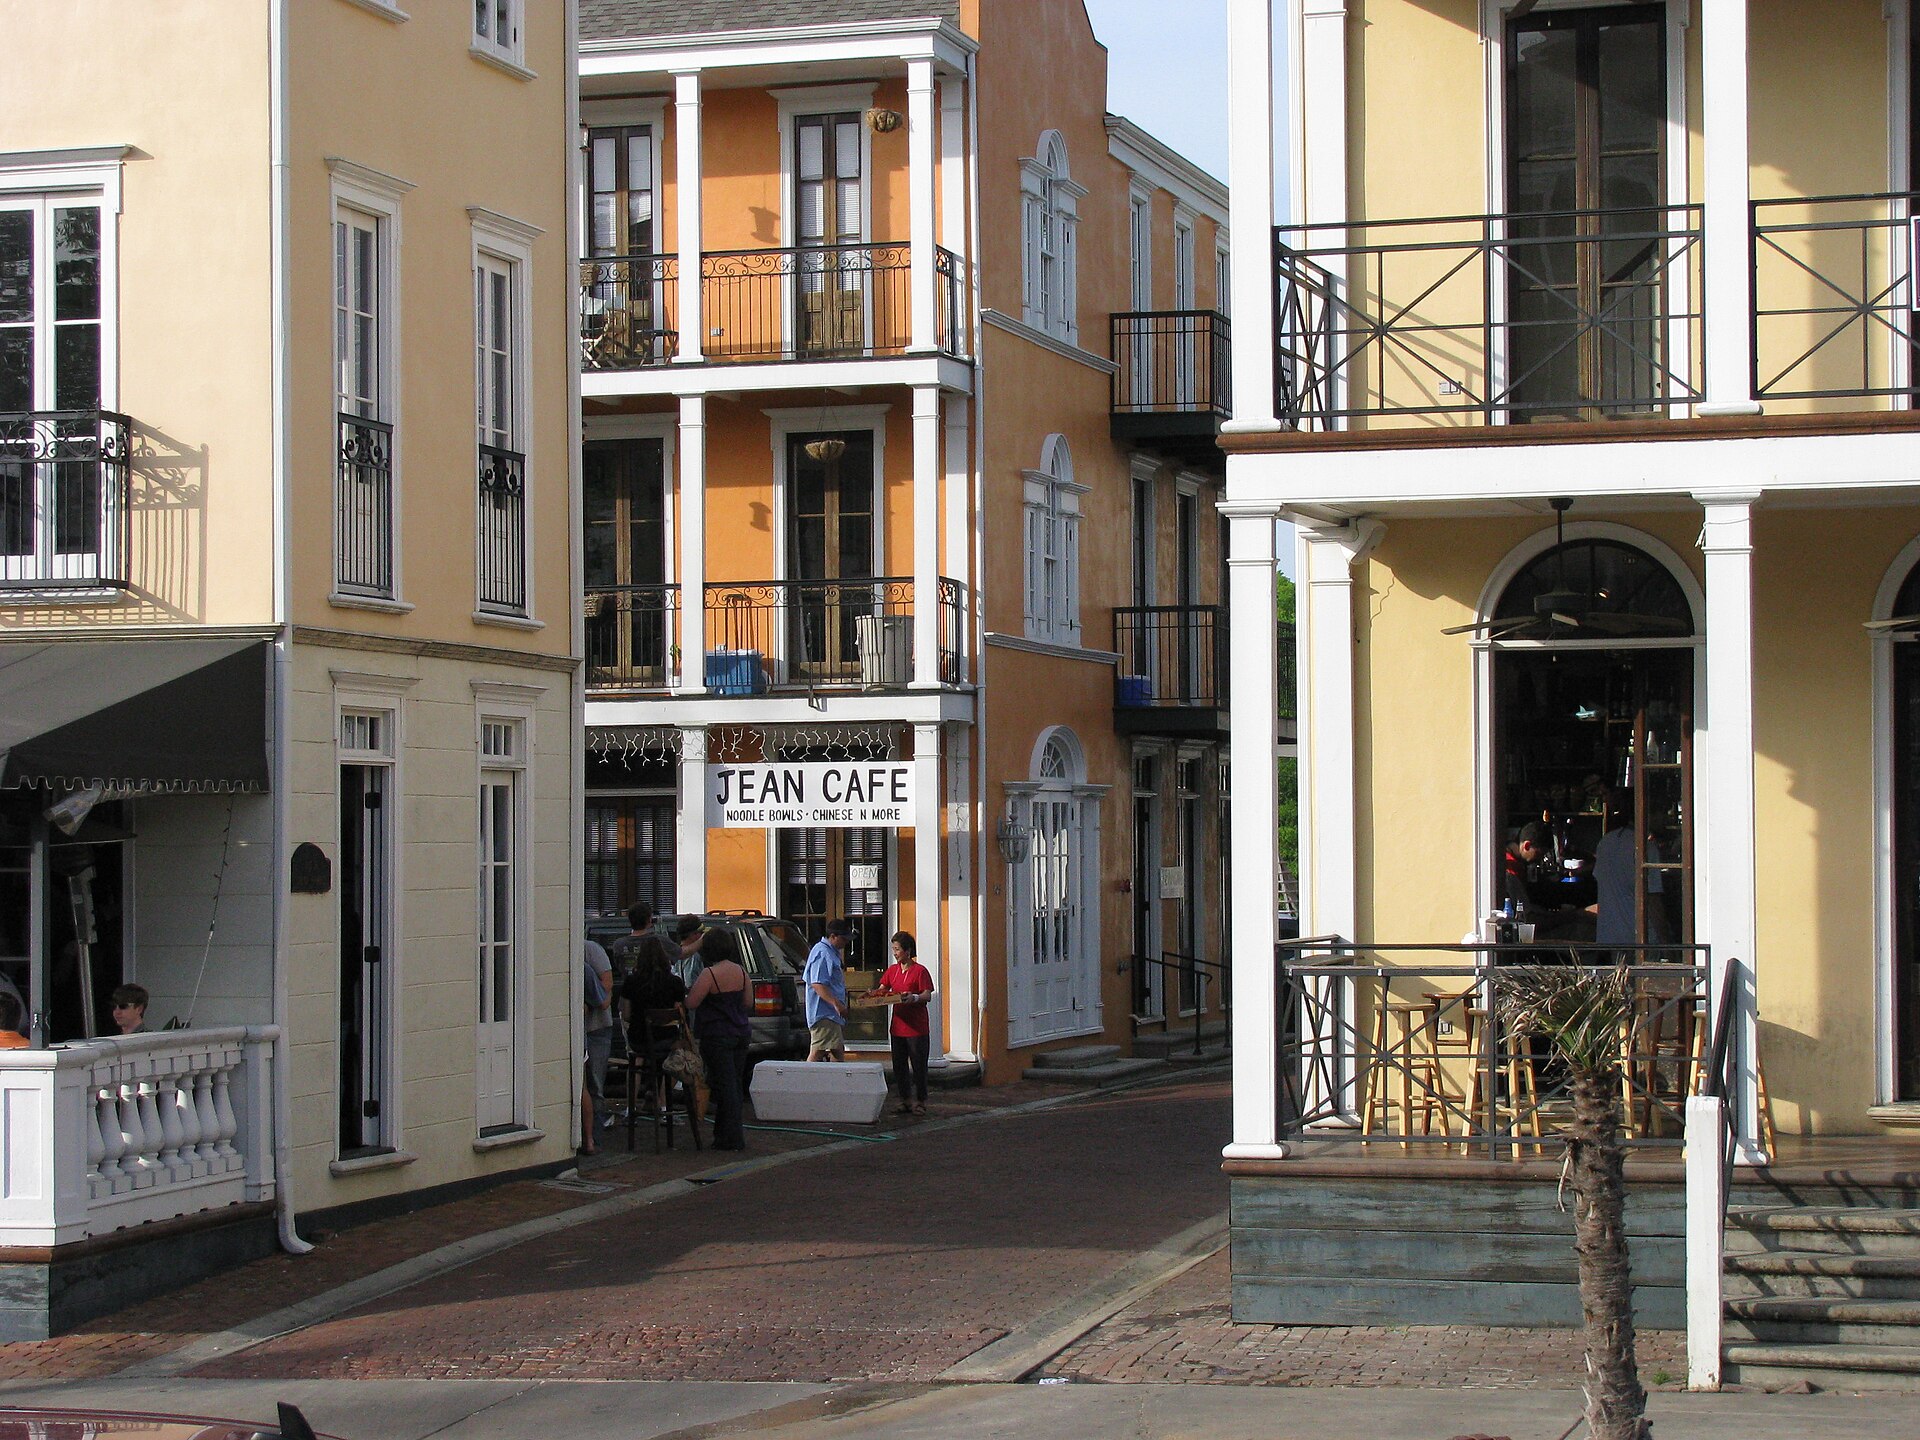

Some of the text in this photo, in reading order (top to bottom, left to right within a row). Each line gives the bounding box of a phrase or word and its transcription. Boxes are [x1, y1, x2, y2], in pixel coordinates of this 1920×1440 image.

[716, 768, 908, 805] JEAN CAFE
[726, 808, 901, 822] NOODLE BOWLS CHINESE N MORE
[852, 867, 877, 878] OPEN
